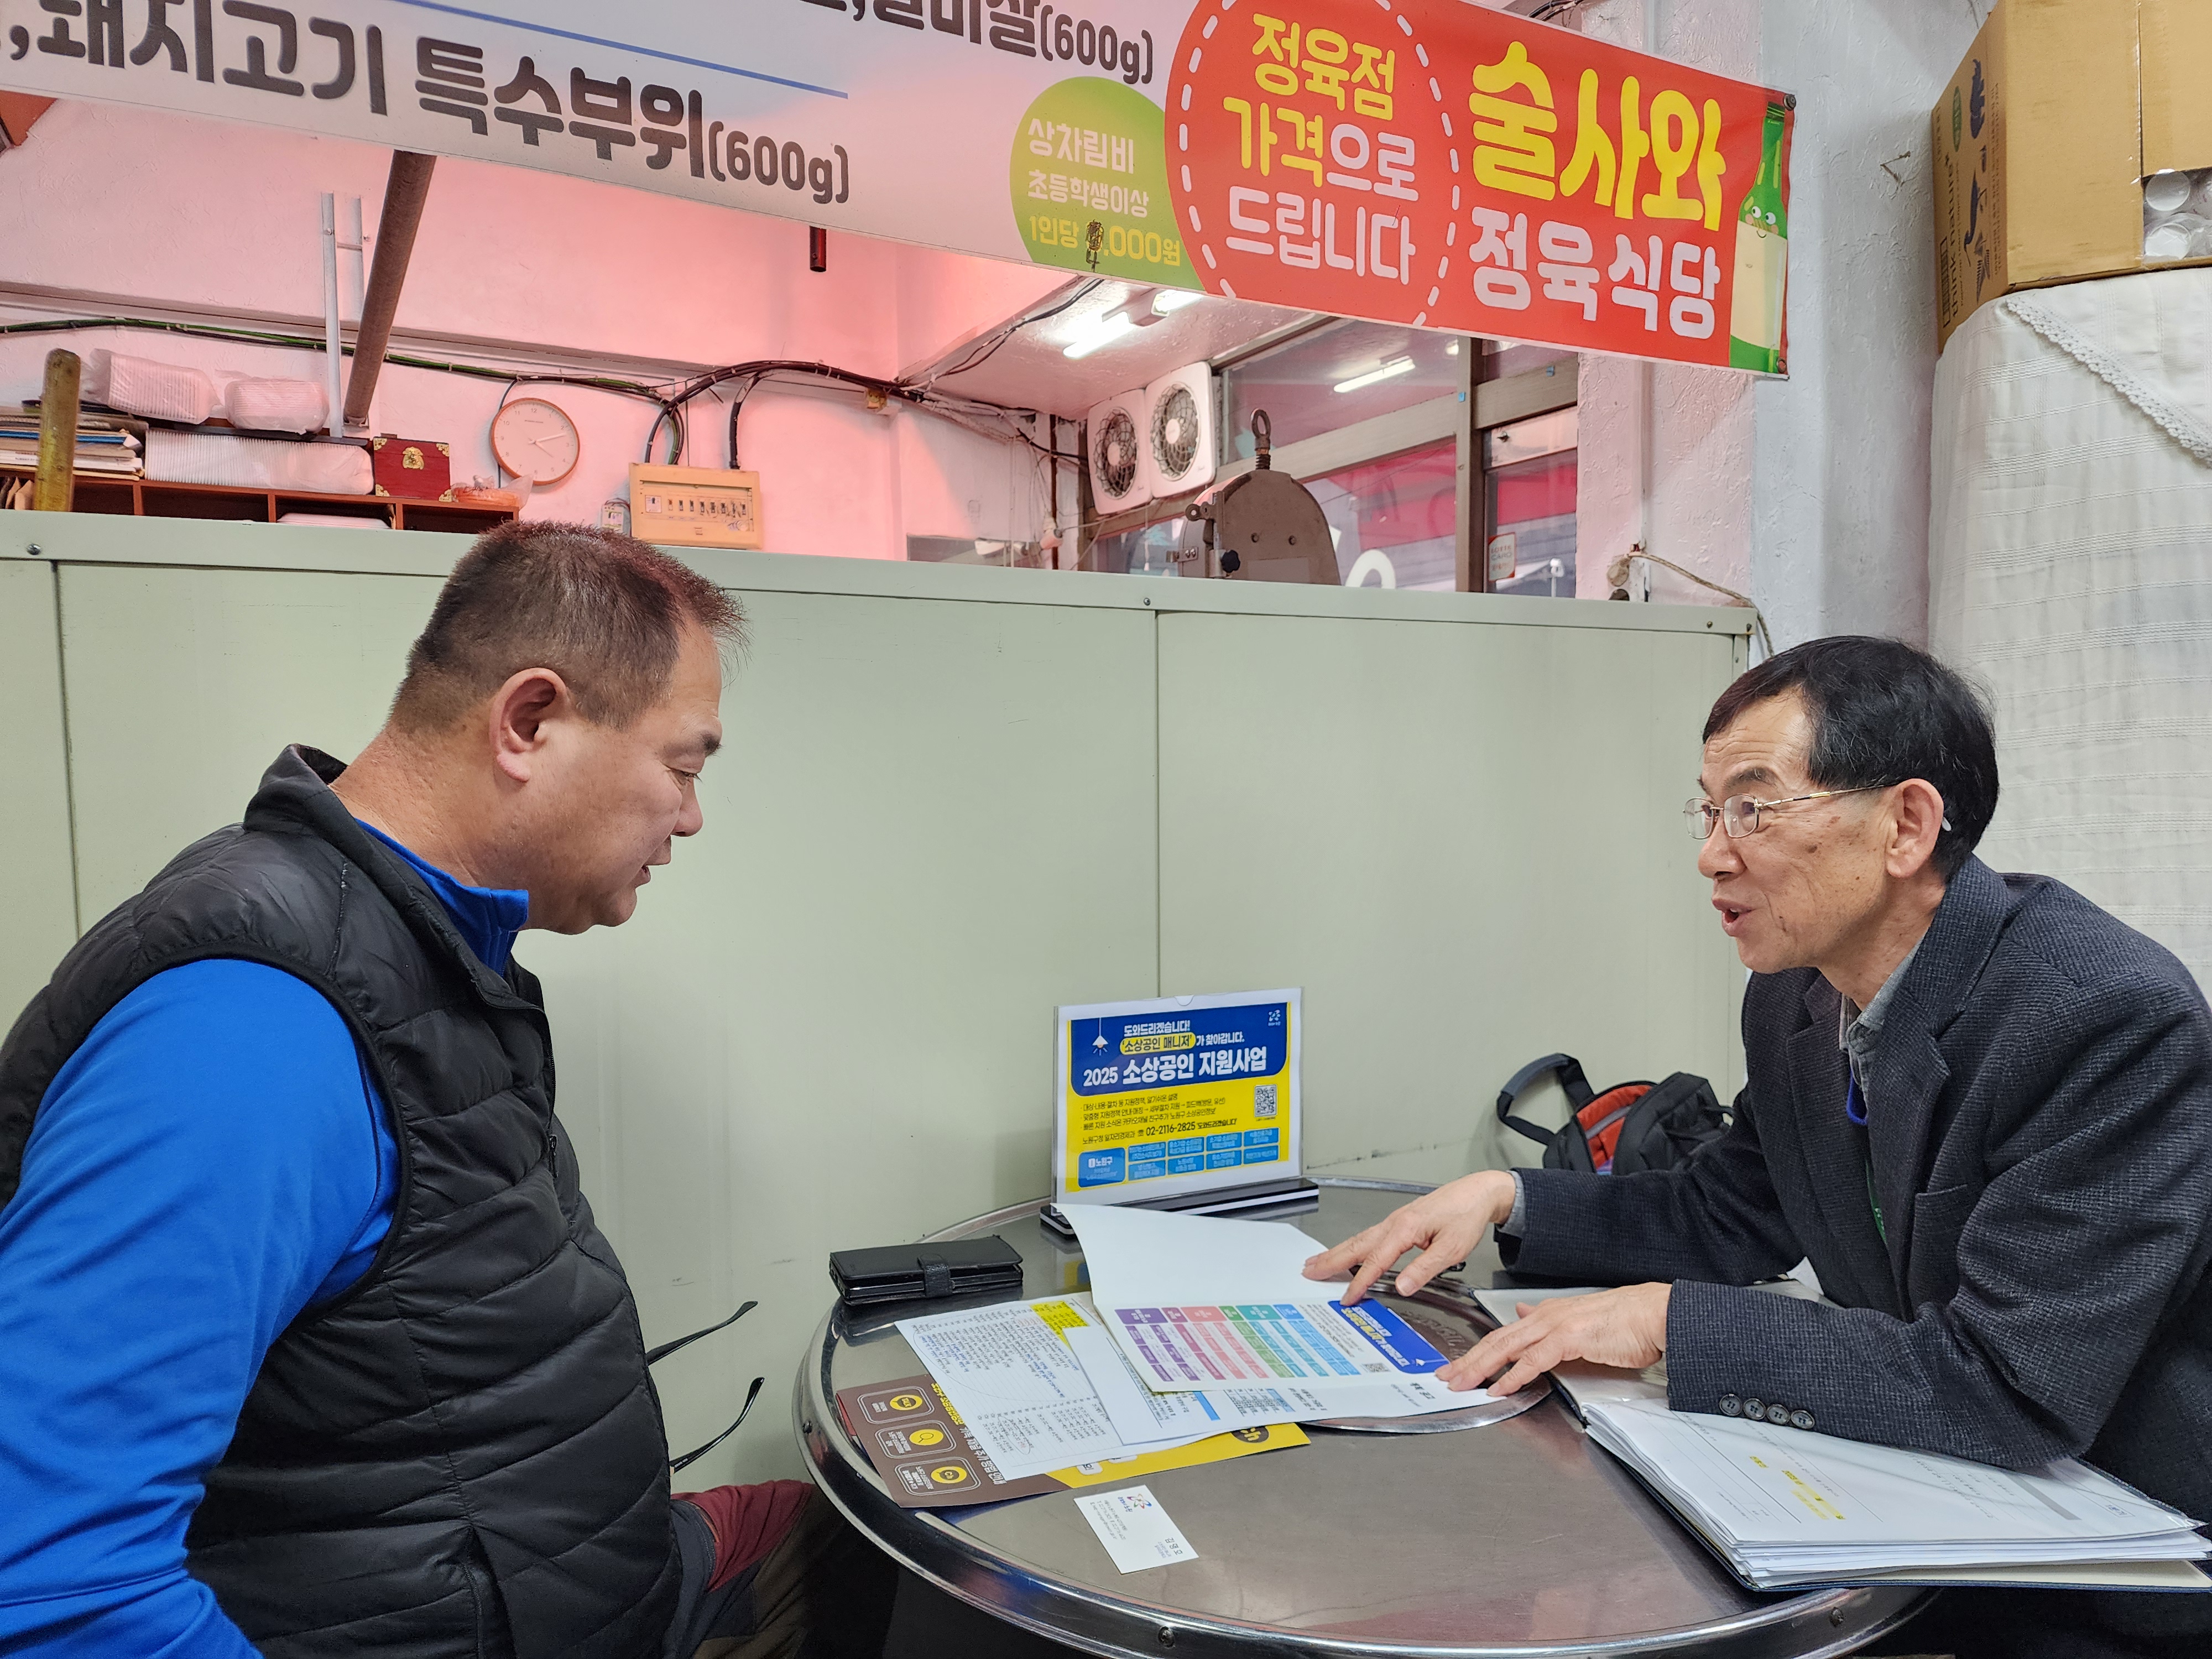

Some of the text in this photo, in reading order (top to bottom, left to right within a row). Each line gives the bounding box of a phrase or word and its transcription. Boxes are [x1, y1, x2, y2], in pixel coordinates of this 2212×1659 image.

[1253, 13, 1395, 120] 정육점
[415, 36, 849, 204] 특수부위(600g)
[1028, 117, 1135, 174] 상차림비
[1223, 97, 1418, 201] 가격으로
[1469, 41, 1726, 231] 술사와
[1027, 169, 1149, 218] 초등학생이상
[1029, 215, 1079, 248] 1인당
[1226, 186, 1416, 285] 드립니다
[1469, 206, 1720, 340] 정육식당
[1083, 1046, 1266, 1086] 2025 소상공인 지원사업
[1124, 1020, 1190, 1037] 도와드리겠습니다!
[1146, 1121, 1196, 1136] 02-2116-2825
